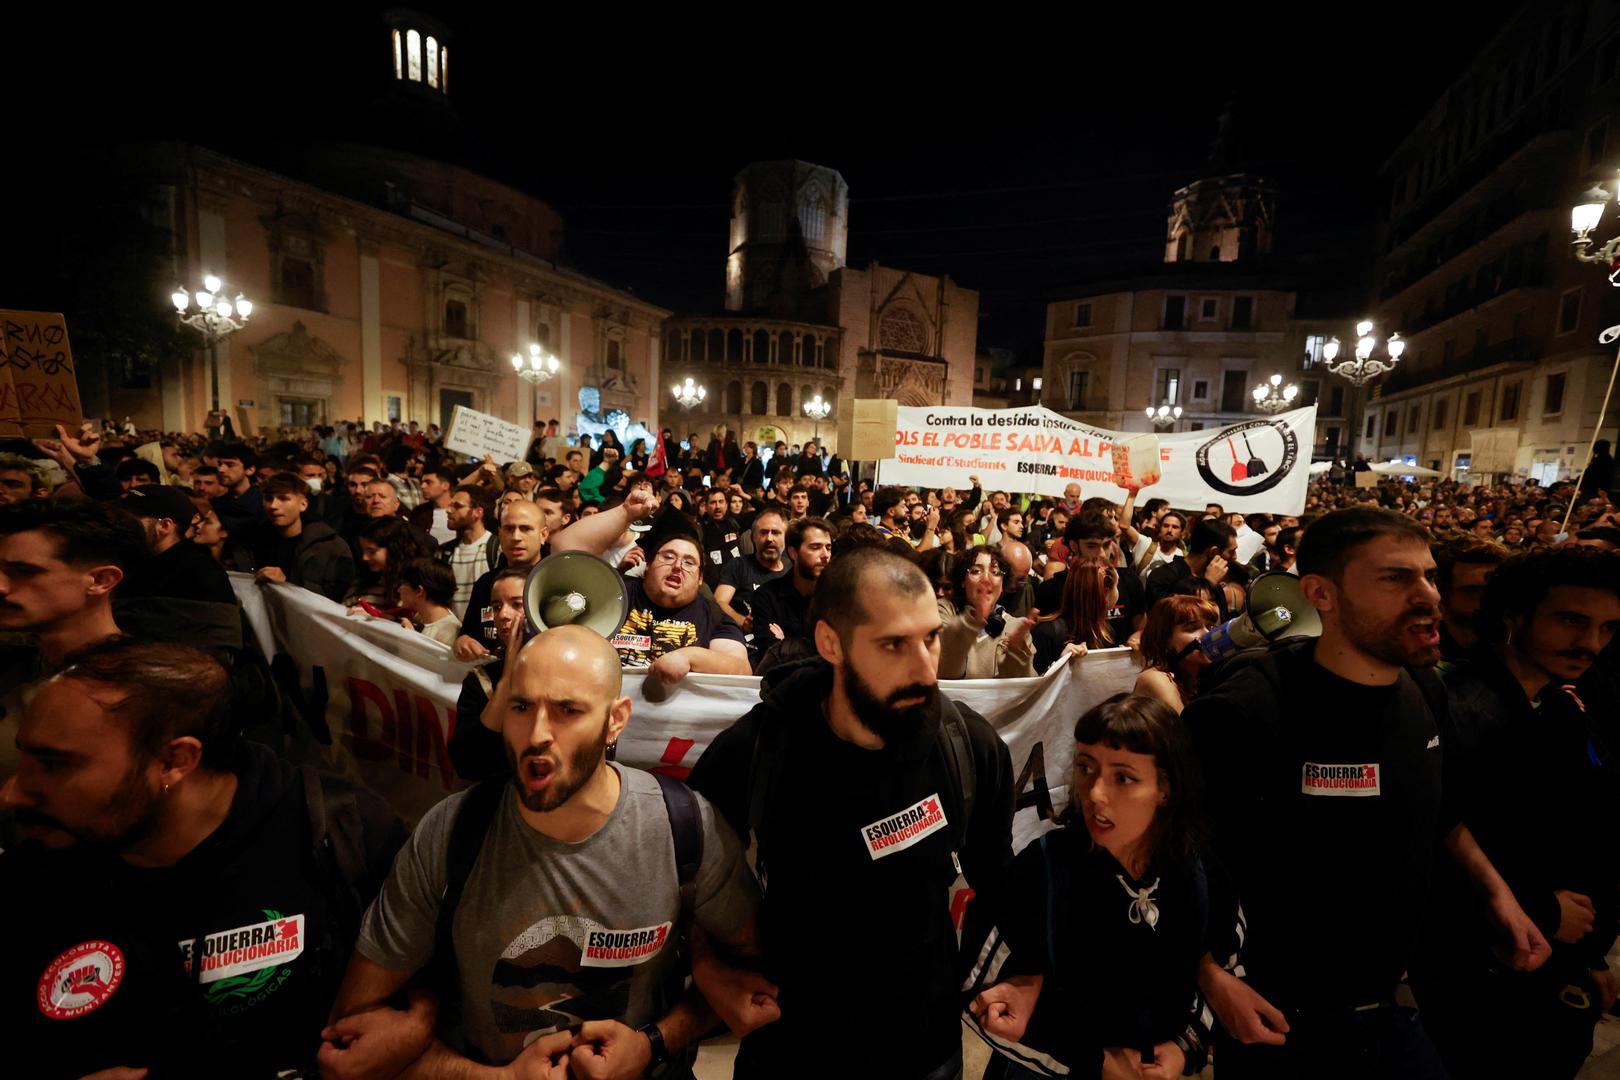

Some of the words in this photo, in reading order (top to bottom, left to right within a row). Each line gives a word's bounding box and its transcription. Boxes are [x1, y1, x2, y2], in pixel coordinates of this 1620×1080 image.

[926, 414, 967, 426] Contra
[971, 414, 983, 426] la
[896, 431, 919, 446] OLS
[923, 432, 939, 446] EL
[943, 432, 1002, 450] POBLE
[1005, 433, 1063, 454] SALVA
[1068, 437, 1093, 457] AL
[898, 453, 935, 467] Sindicat
[1069, 468, 1112, 482] REVOLUCI
[348, 677, 457, 792] DIN
[1305, 765, 1364, 779] ESQUERRA
[1305, 776, 1377, 788] REVOLUCIONARIA
[866, 805, 926, 841] ESQUERRA
[870, 810, 943, 852] REVOLUCIONARIA
[589, 930, 656, 948] ESQUERRA
